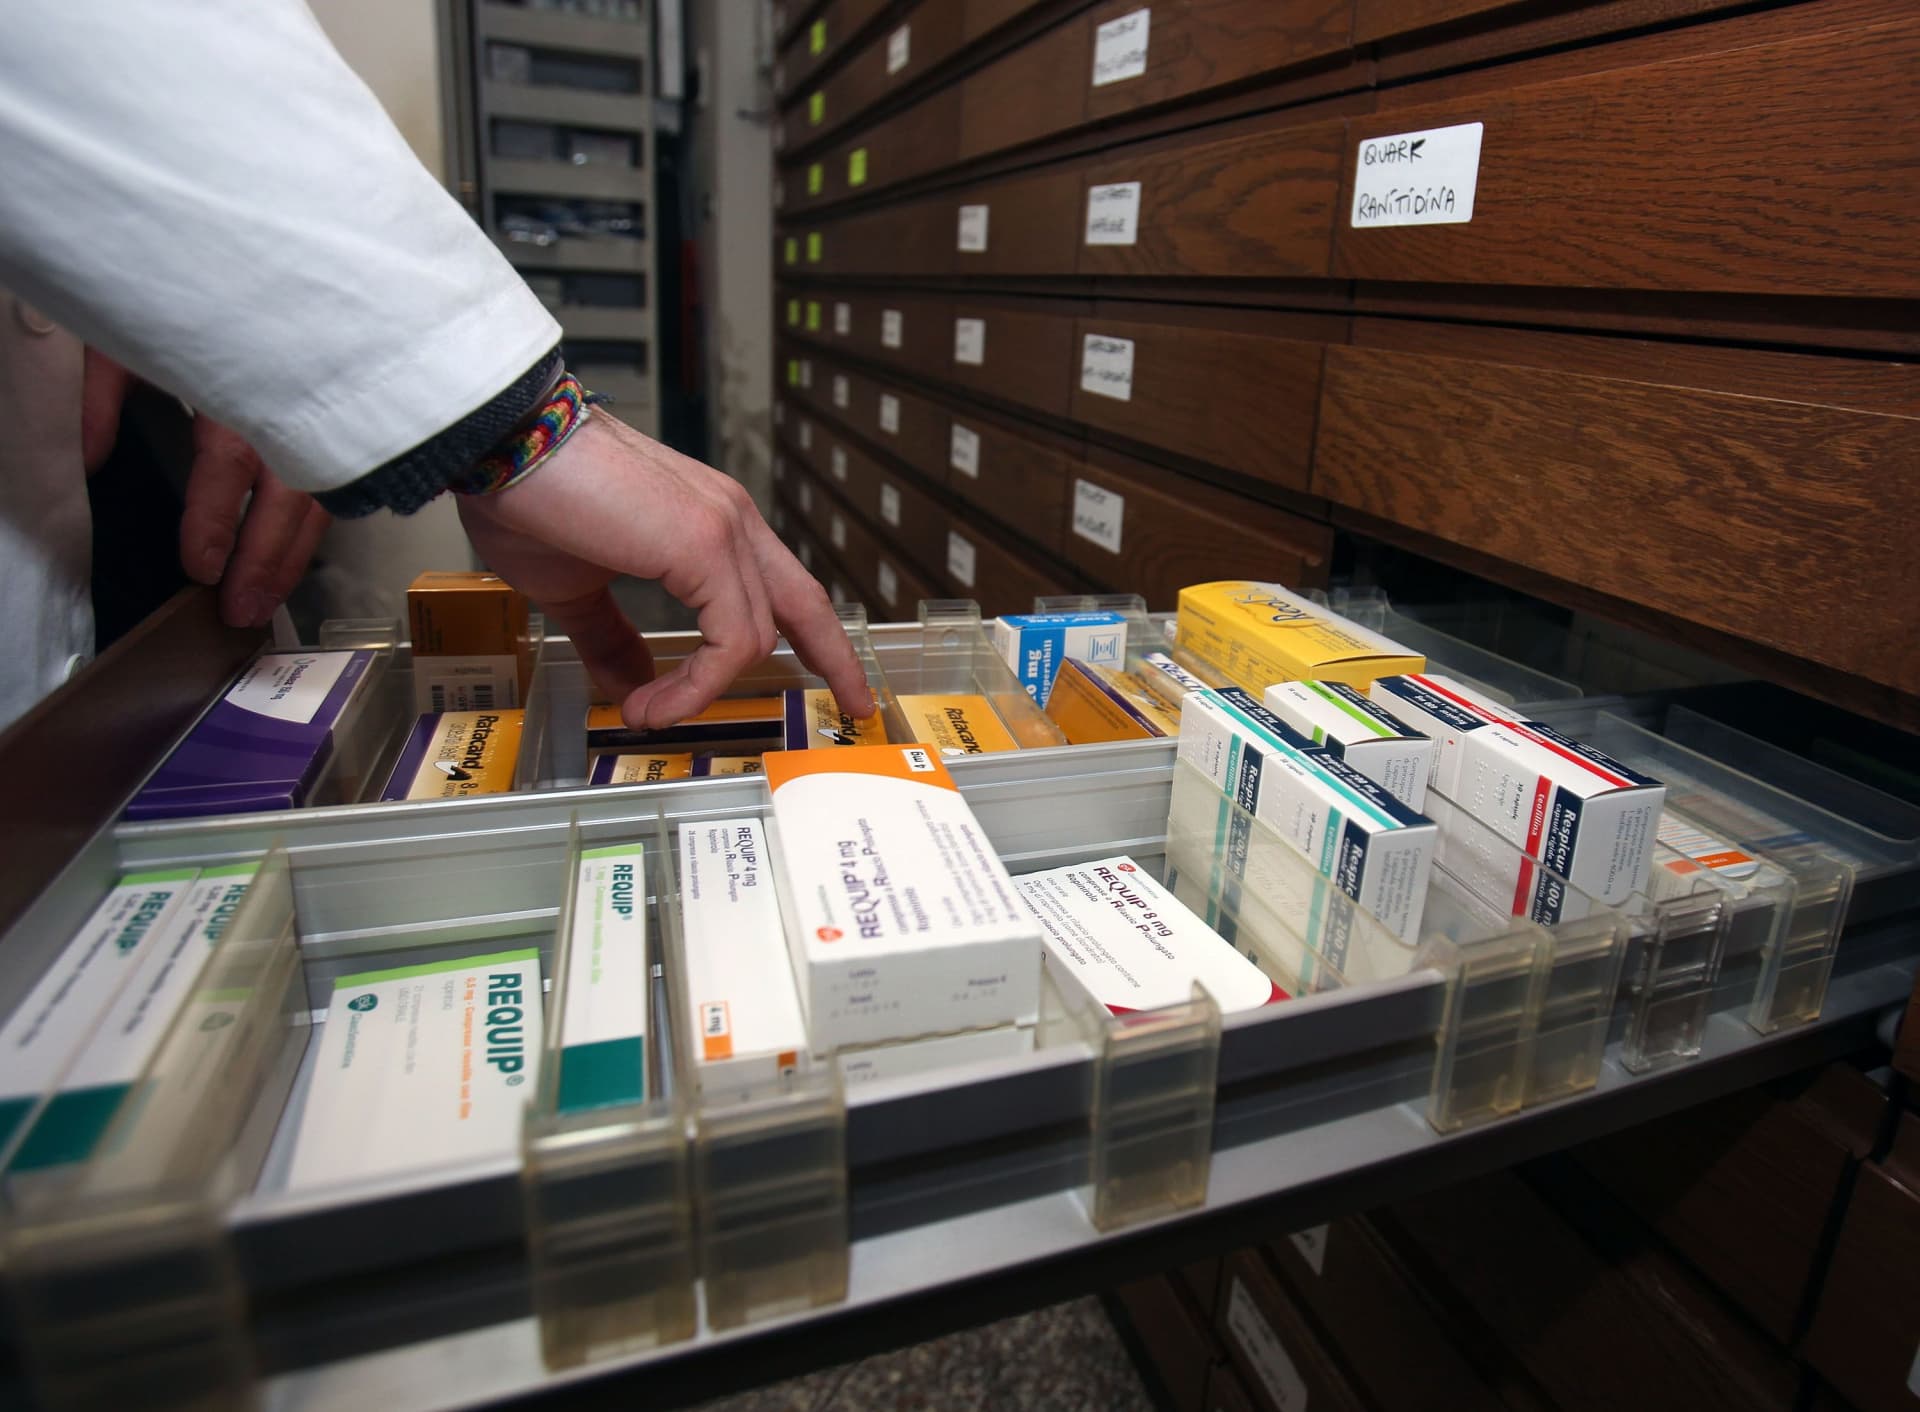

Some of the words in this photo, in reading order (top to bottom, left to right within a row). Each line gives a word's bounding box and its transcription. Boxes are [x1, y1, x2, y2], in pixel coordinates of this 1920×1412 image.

[1364, 138, 1426, 165] QUARK
[1359, 186, 1455, 219] RANITIDINA
[1028, 649, 1042, 678] mg
[461, 715, 500, 769] Ratacand
[646, 760, 668, 781] Rata
[910, 751, 924, 763] mg
[1226, 750, 1237, 792] teofillina
[1511, 794, 1520, 819] capsule
[1533, 794, 1544, 837] teofillina
[1552, 802, 1561, 835] capsule
[835, 840, 856, 858] mg
[1546, 835, 1557, 860] rigide
[1557, 808, 1575, 871] Respicur
[840, 860, 858, 868] 4
[742, 872, 757, 887] mg
[1063, 873, 1098, 901] Ropinirolo
[1079, 870, 1109, 895] compresse
[1108, 901, 1136, 923] Rilascio
[1136, 925, 1174, 959] Prolungato
[1151, 921, 1174, 937] mg
[1056, 937, 1086, 964] prolungato
